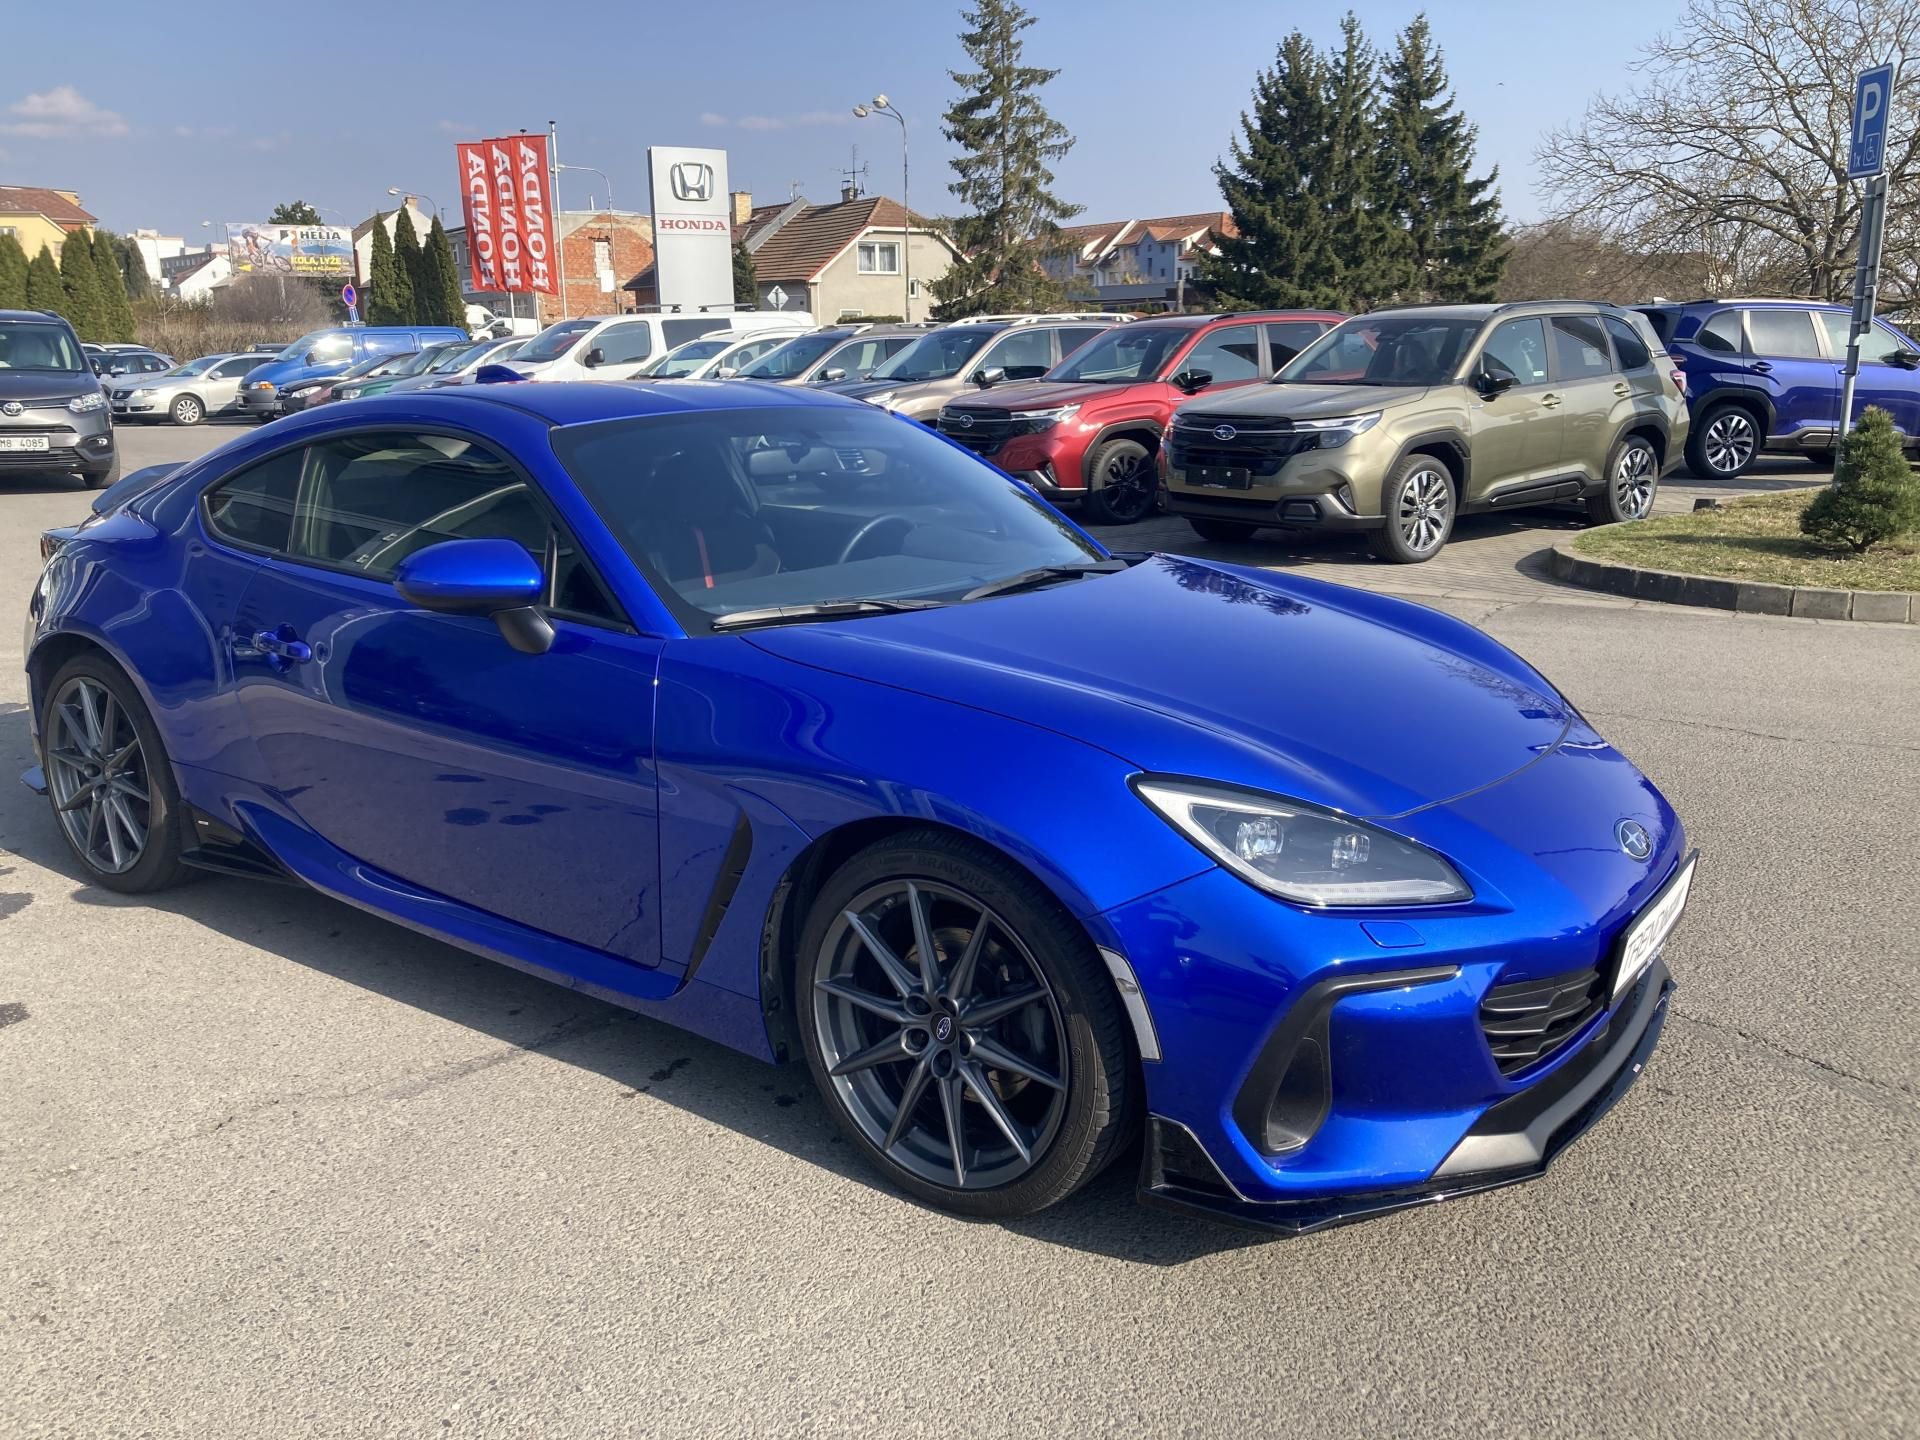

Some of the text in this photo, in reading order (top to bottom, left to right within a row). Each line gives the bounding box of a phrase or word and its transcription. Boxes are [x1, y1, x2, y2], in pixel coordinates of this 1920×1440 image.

[1858, 82, 1881, 143] P
[659, 219, 727, 231] HONDA
[300, 231, 341, 240] HELIA
[20, 438, 44, 448] 4085
